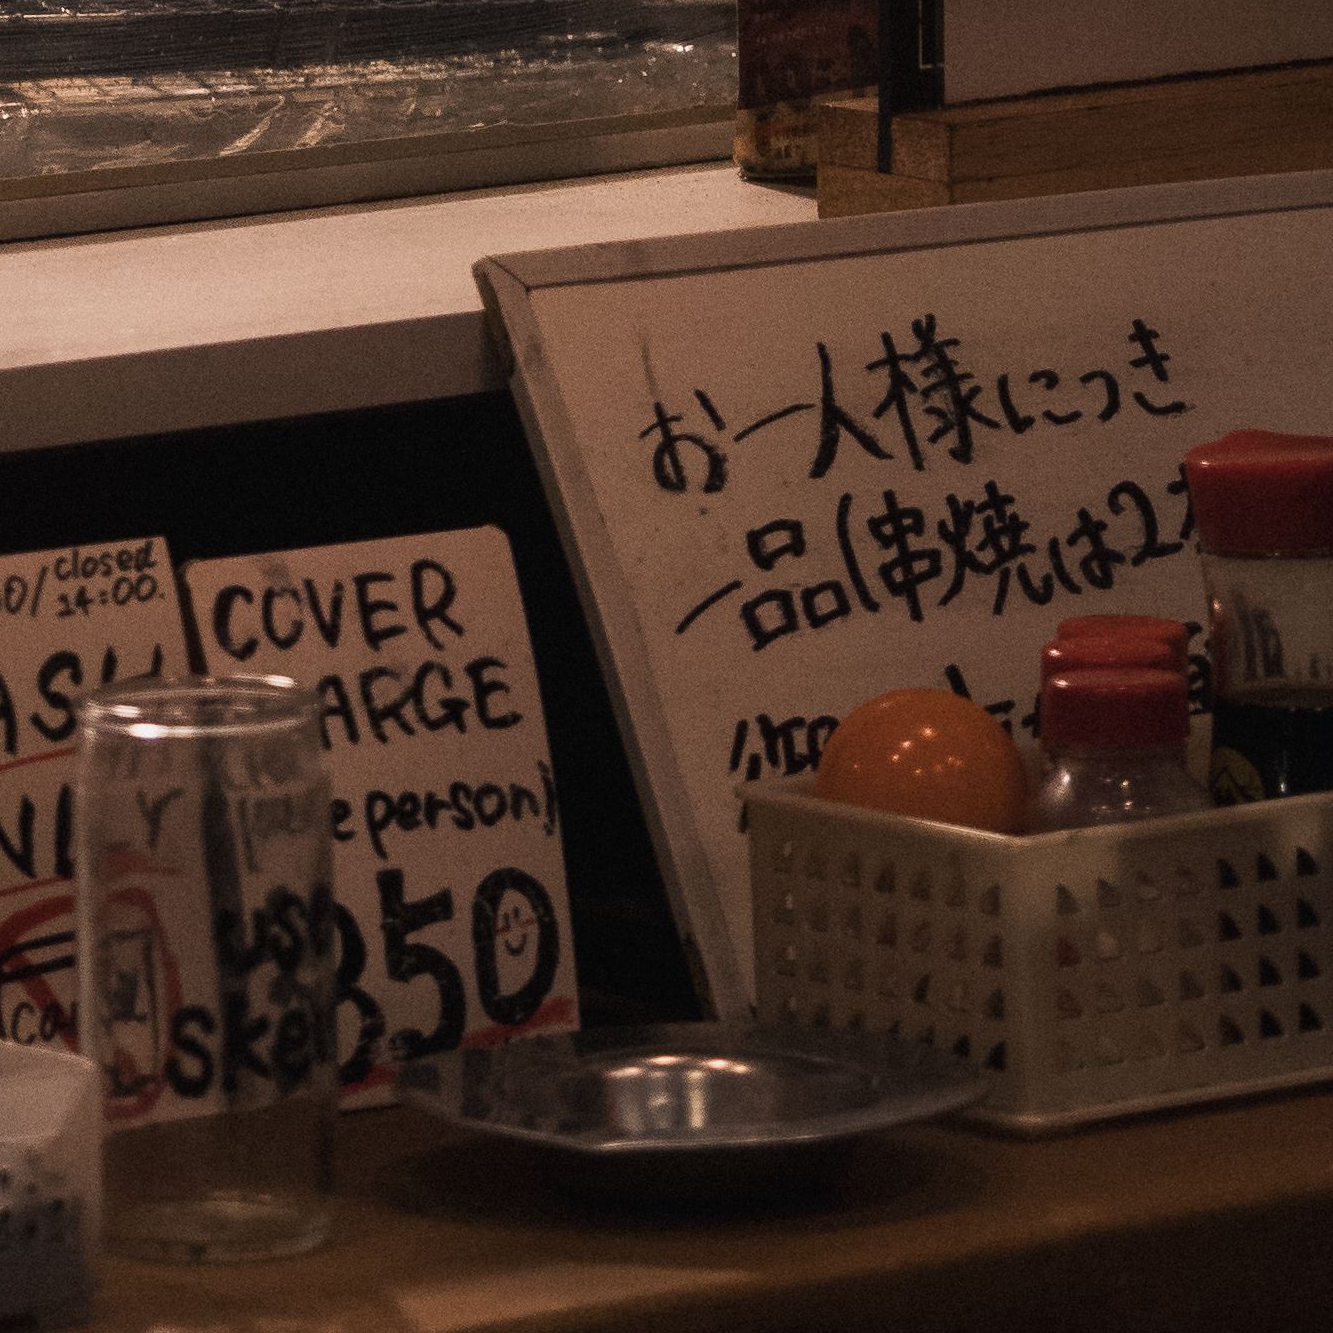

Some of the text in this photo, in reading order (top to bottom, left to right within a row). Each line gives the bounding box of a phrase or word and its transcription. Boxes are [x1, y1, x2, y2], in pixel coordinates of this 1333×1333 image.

[639, 314, 1195, 494] お一人様につき
[213, 559, 465, 661] COVER
